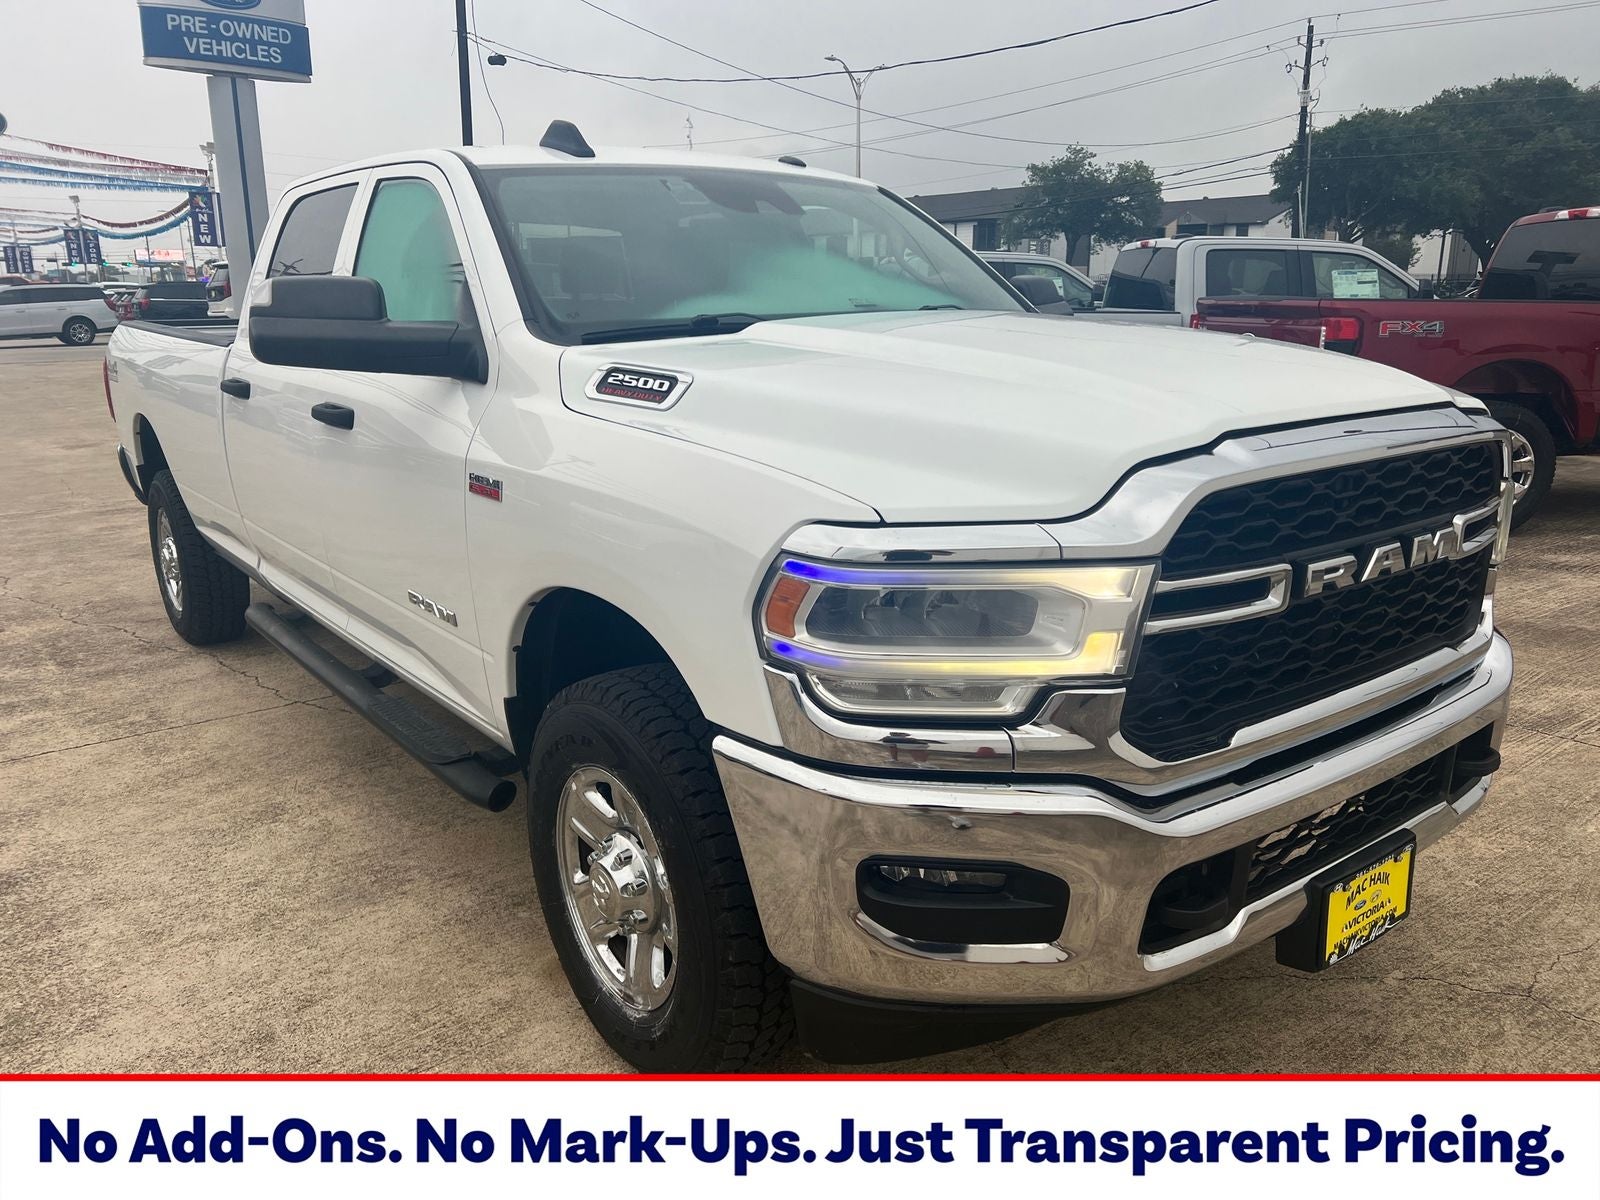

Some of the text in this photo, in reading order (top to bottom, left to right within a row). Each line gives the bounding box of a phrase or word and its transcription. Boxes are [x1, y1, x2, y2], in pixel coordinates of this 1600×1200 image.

[183, 36, 282, 63] VEHICLES
[198, 213, 212, 244] NEW
[70, 242, 80, 263] NEW
[1378, 320, 1445, 337] FX4
[607, 372, 670, 391] 2500
[1304, 526, 1460, 598] RAM
[1345, 871, 1391, 911] MAC HAIK
